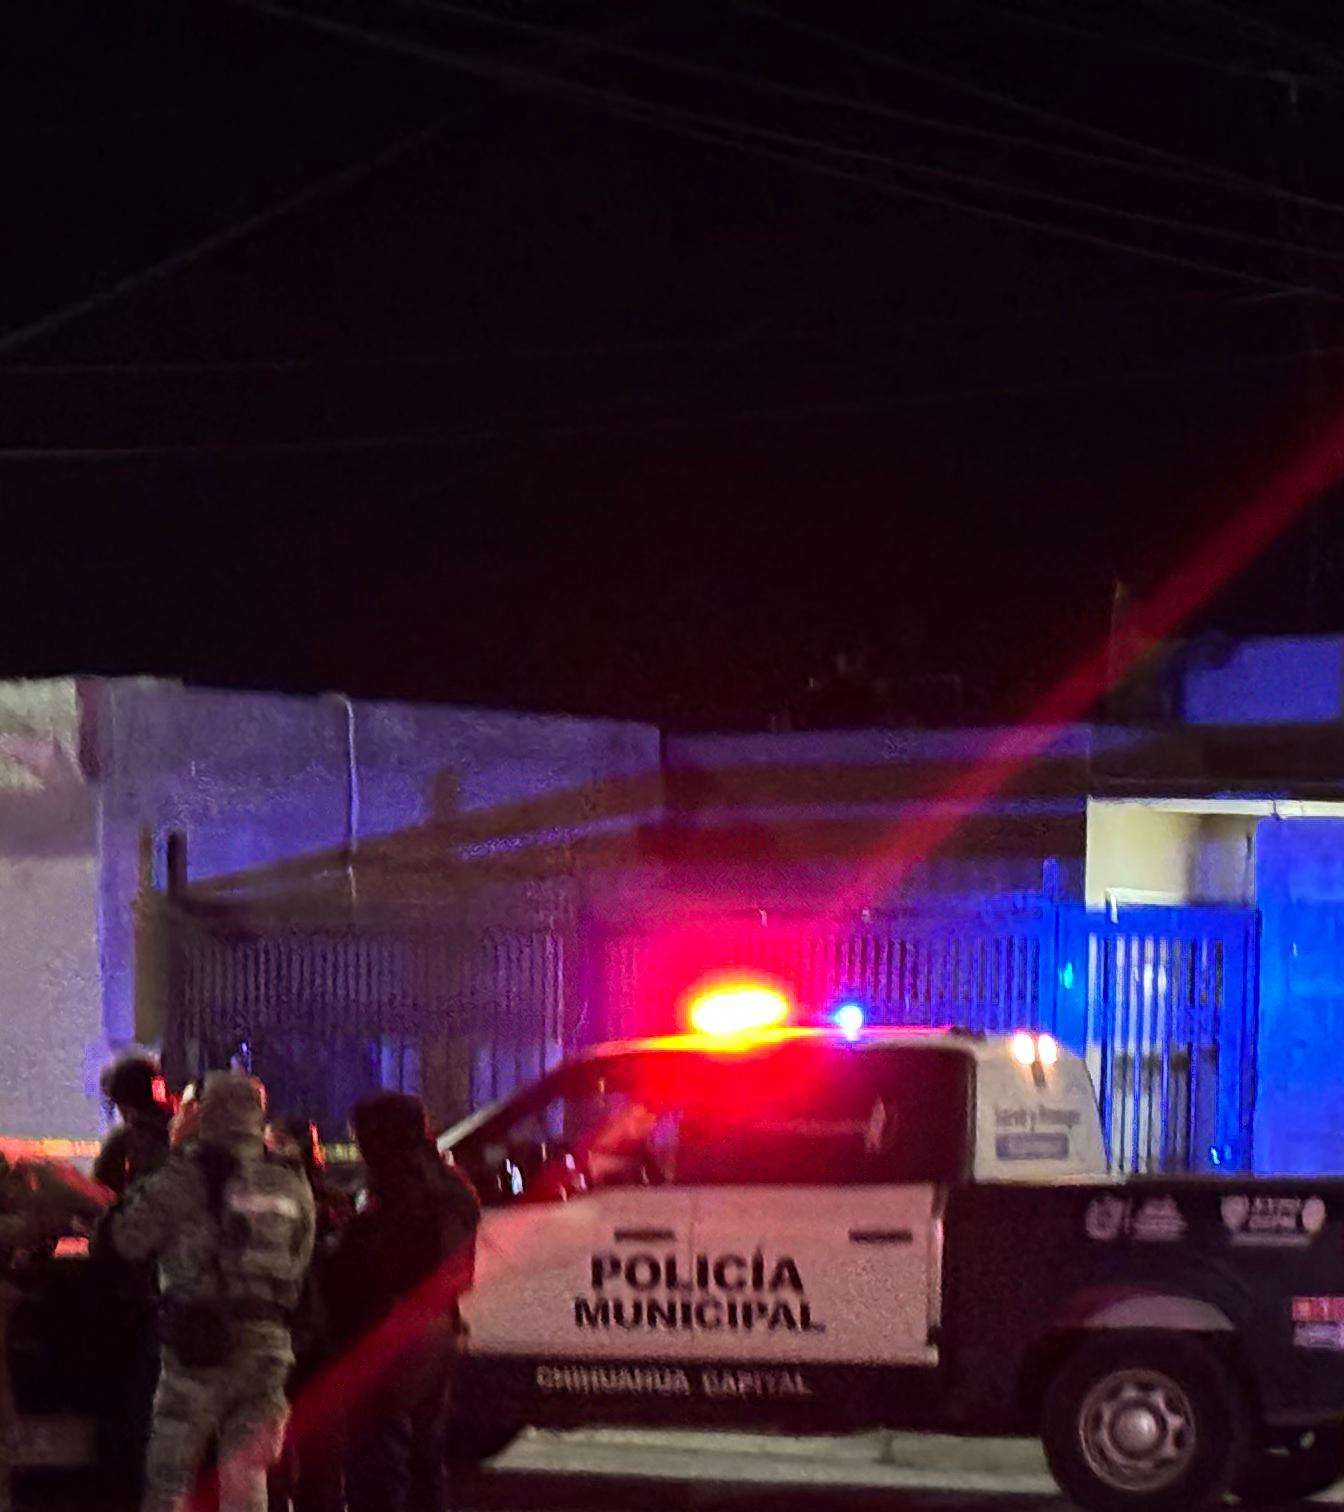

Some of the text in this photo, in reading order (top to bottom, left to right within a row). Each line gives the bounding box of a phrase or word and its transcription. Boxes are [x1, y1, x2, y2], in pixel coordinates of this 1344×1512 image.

[591, 1246, 804, 1292] POLICÍA
[573, 1297, 826, 1332] MUNICIPAL
[536, 1363, 815, 1398] CHIHUAHUA CAPITAL
